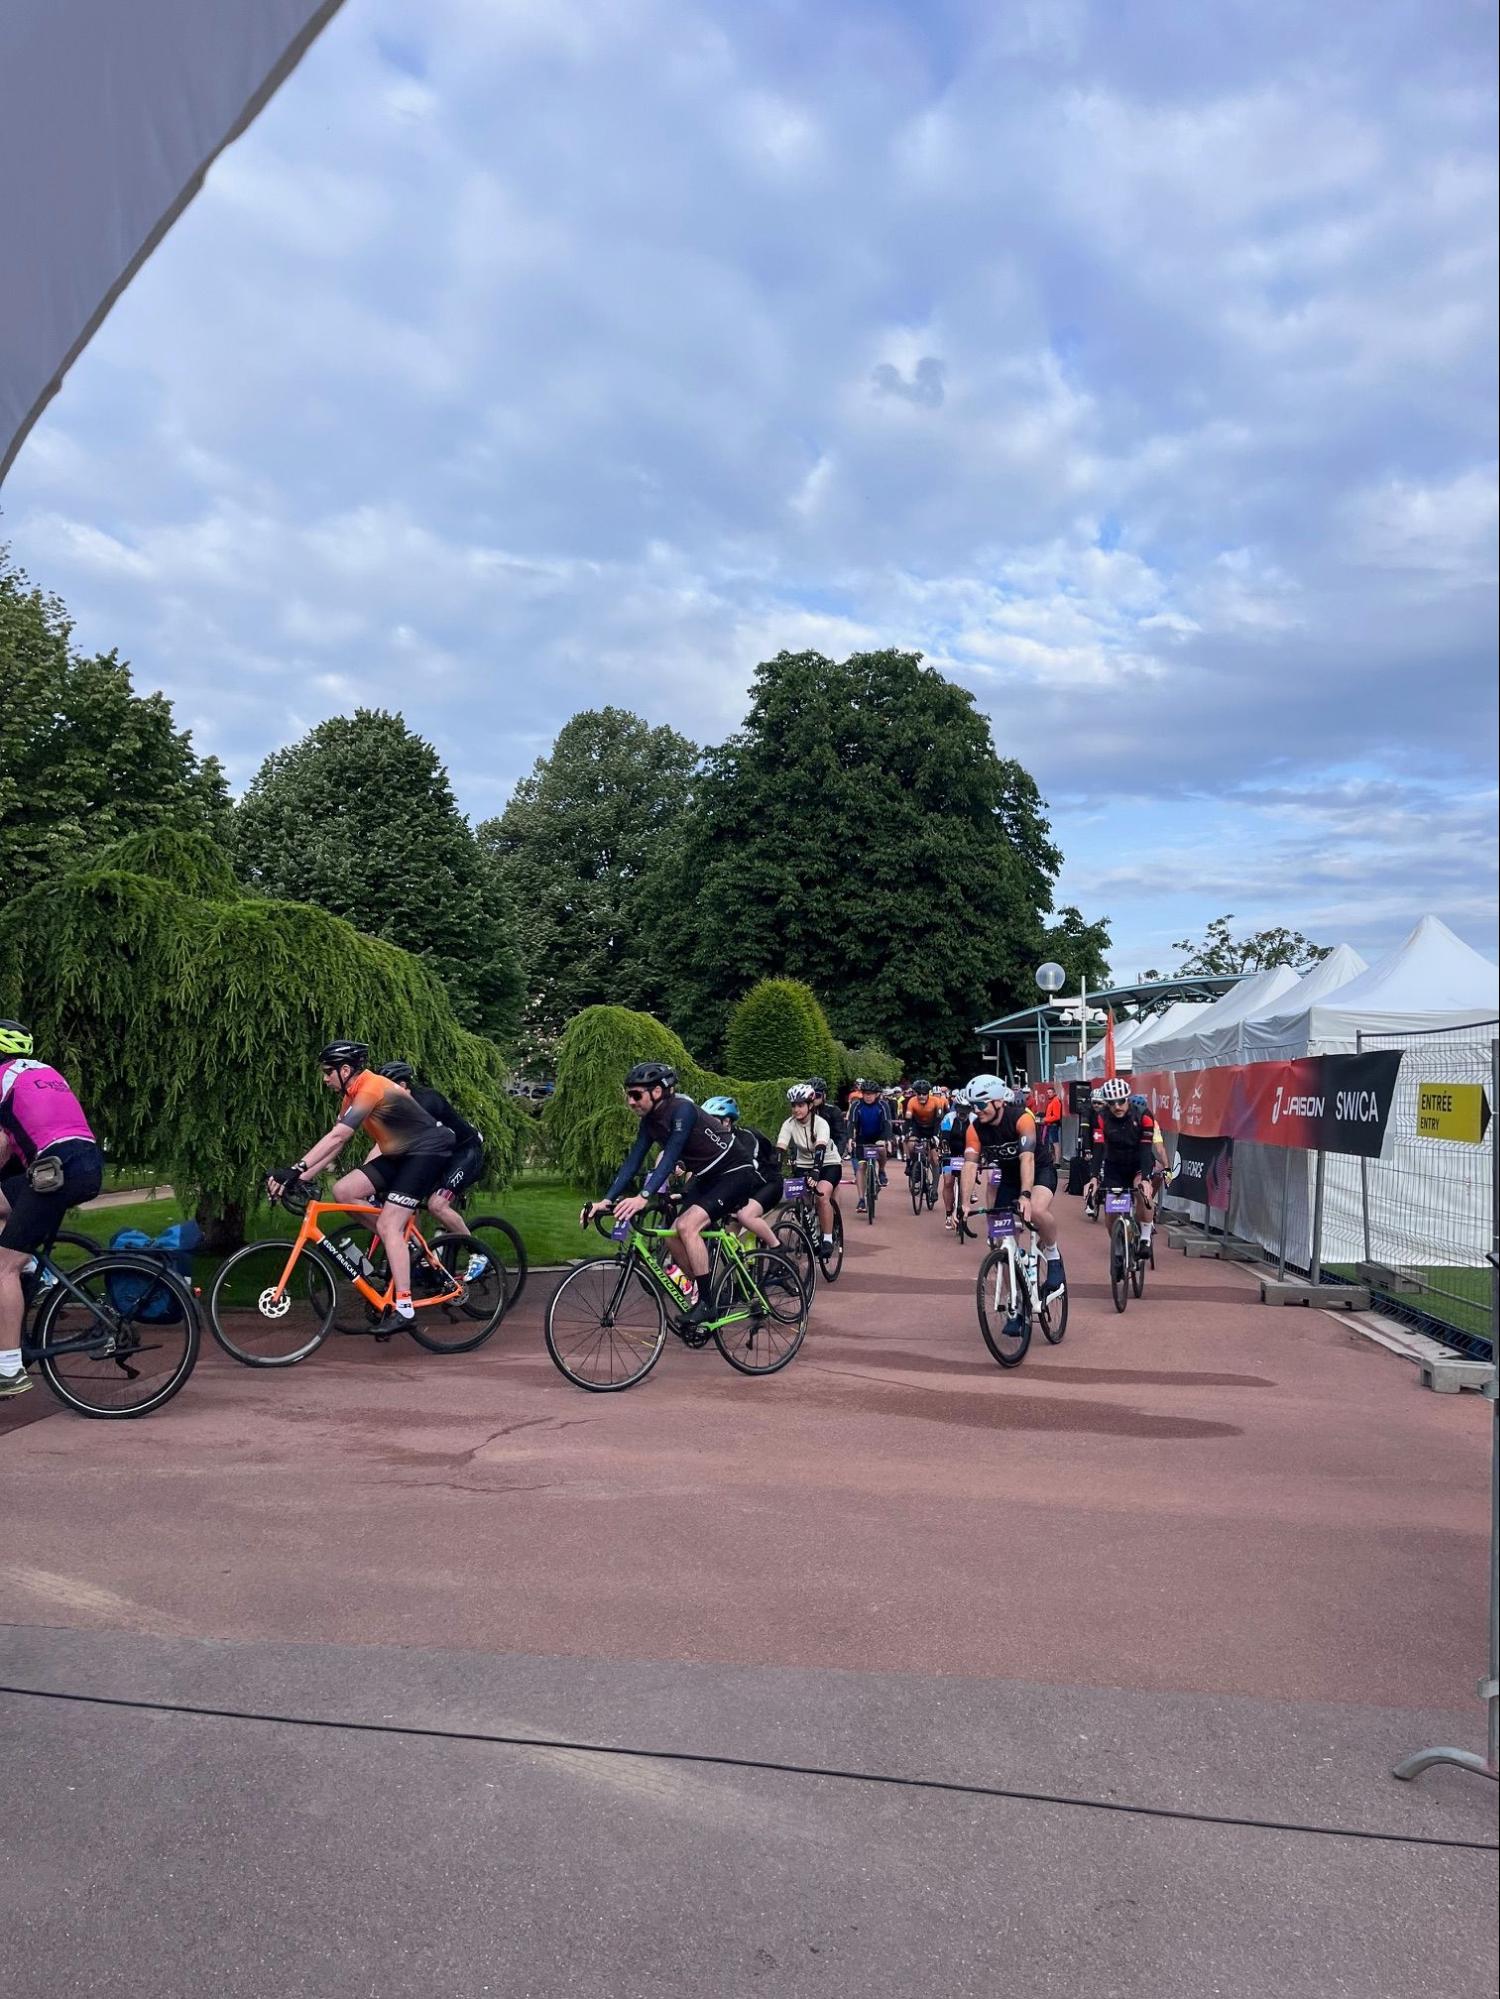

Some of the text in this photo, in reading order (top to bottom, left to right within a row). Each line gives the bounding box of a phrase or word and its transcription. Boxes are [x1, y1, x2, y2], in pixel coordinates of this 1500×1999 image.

[1282, 1096, 1326, 1118] JAISON
[1335, 1090, 1379, 1122] SWICA
[1421, 1089, 1453, 1112] ENTRÉE
[1420, 1116, 1440, 1131] ENTRY
